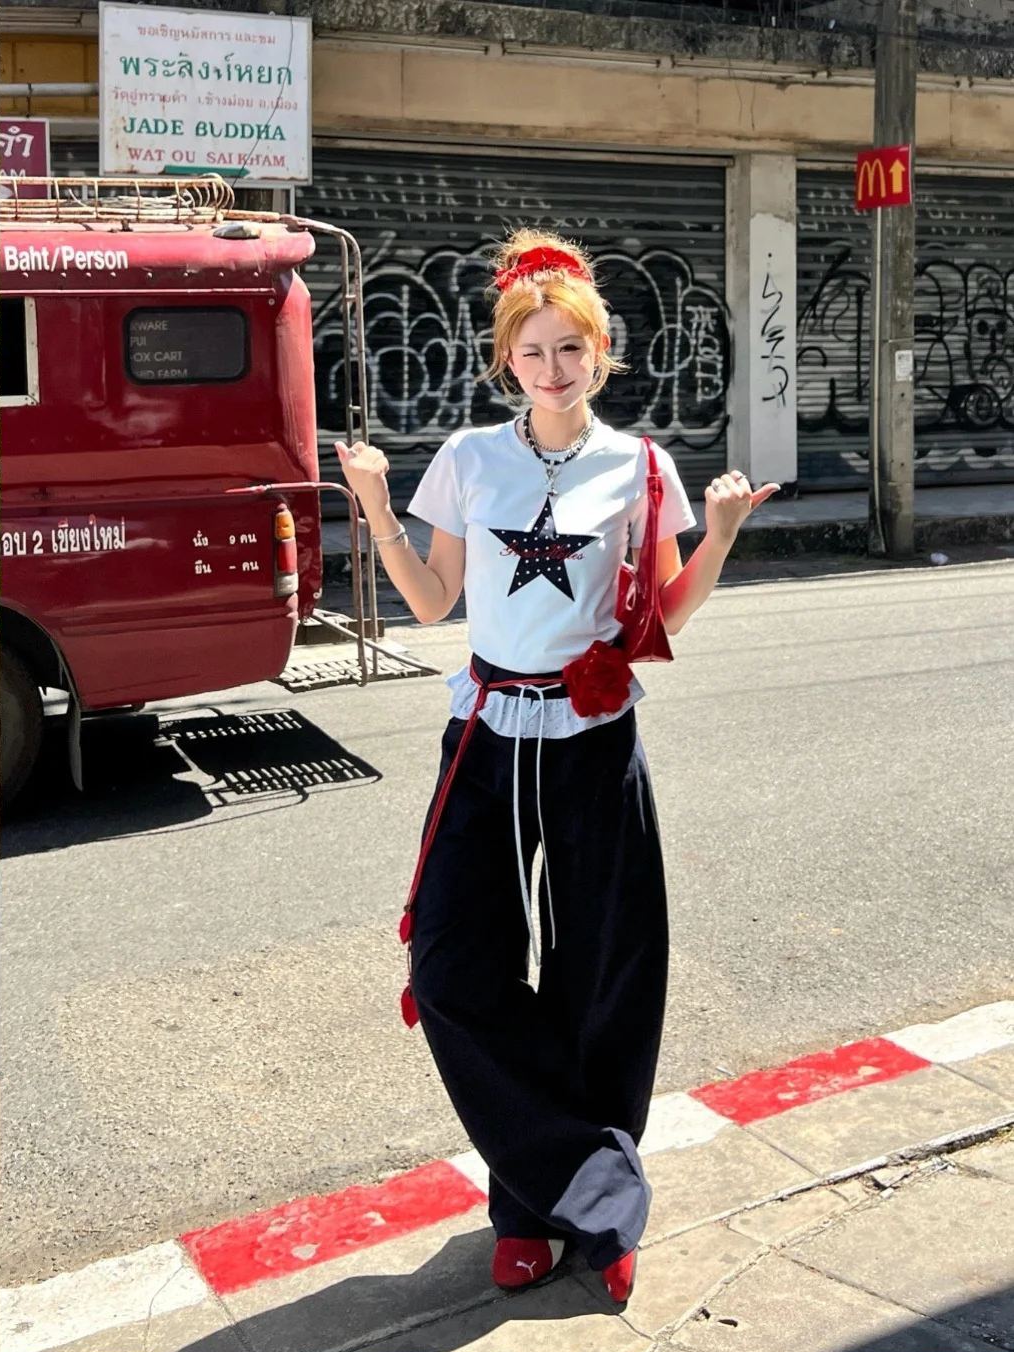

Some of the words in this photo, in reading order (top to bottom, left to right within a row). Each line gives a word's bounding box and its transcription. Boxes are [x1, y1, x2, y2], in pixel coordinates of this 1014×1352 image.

[123, 117, 185, 136] JADE
[195, 121, 287, 141] BUDDHA
[128, 147, 166, 162] WAT
[172, 150, 196, 164] OU
[206, 151, 233, 165] SAI
[3, 245, 128, 272] Baht/Person
[154, 351, 182, 362] CART
[32, 531, 44, 554] 2
[51, 514, 126, 554] เชียงใหม่
[229, 535, 236, 545] 9
[240, 533, 258, 544] คน
[242, 561, 259, 572] คน
